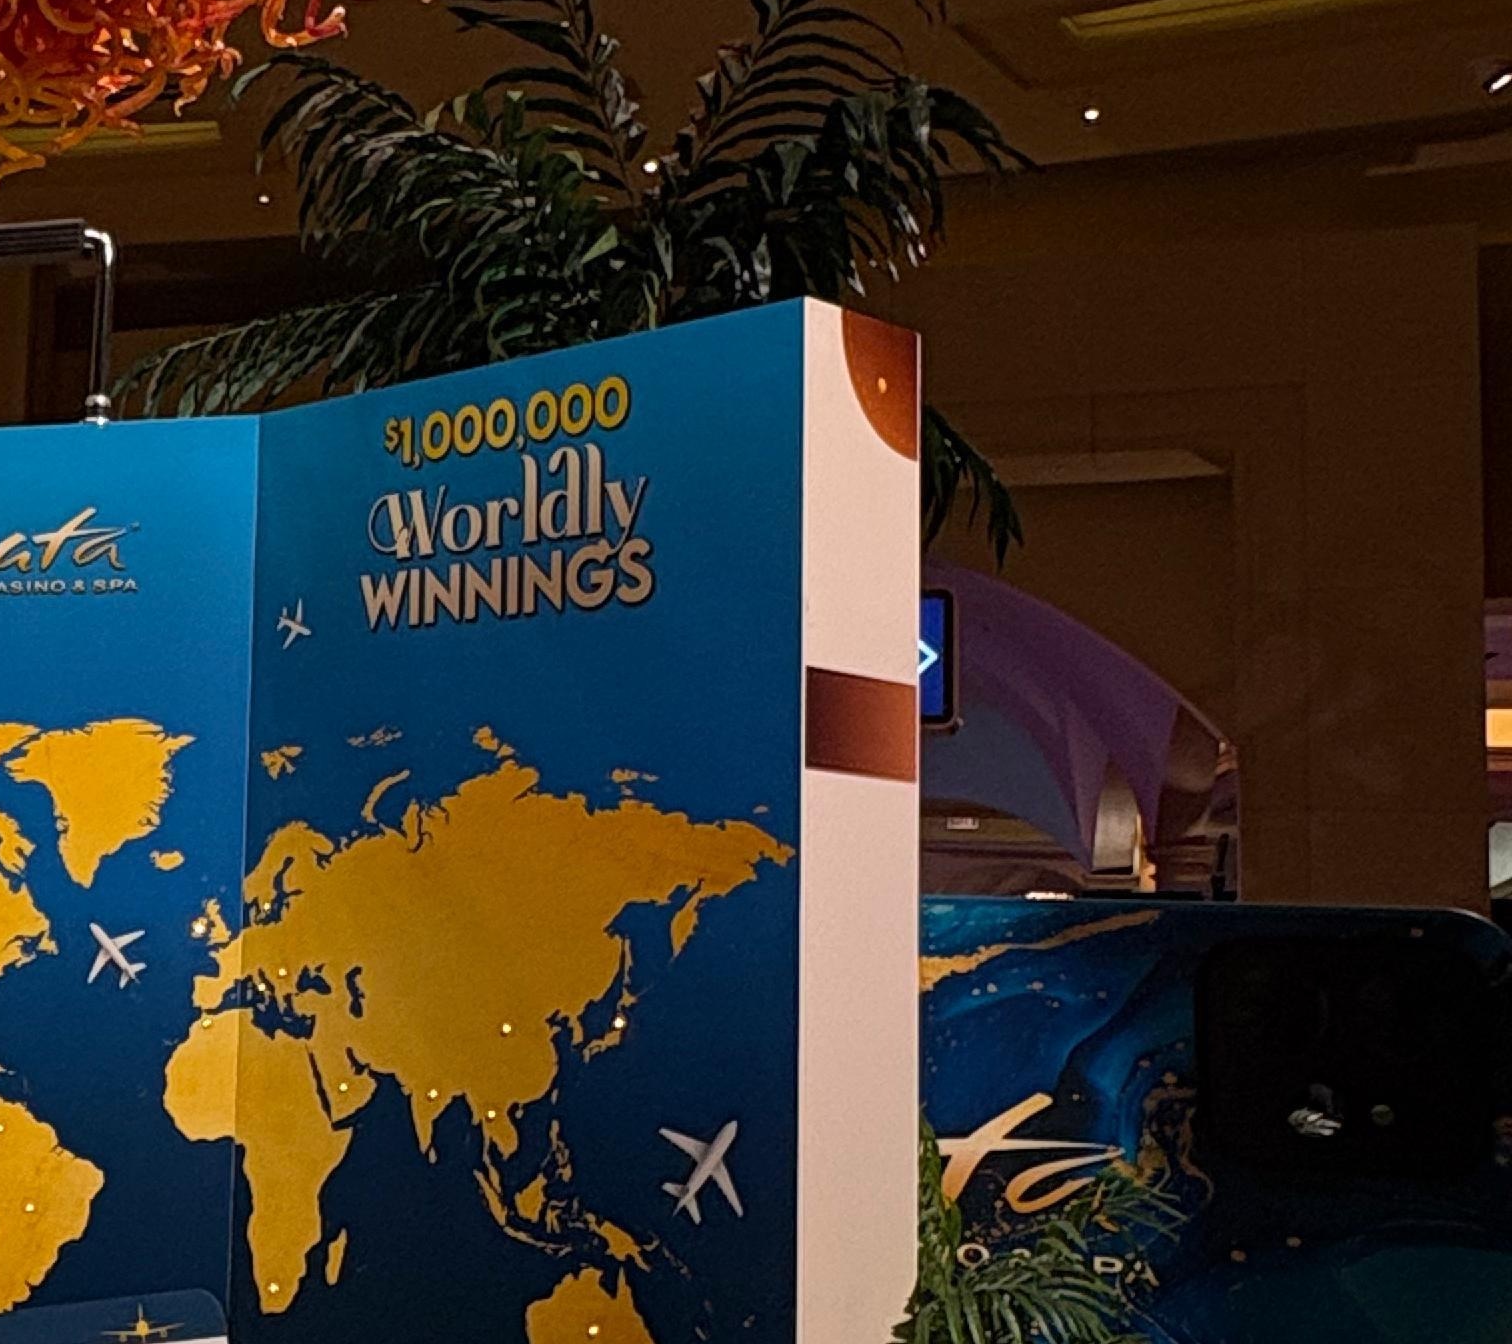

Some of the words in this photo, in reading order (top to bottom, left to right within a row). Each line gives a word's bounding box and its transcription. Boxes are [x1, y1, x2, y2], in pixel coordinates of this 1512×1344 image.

[384, 375, 630, 469] $1,000,000
[367, 442, 648, 559] Worldly
[70, 580, 86, 595] &
[91, 577, 139, 594] SPA
[360, 538, 654, 631] WINNINGS
